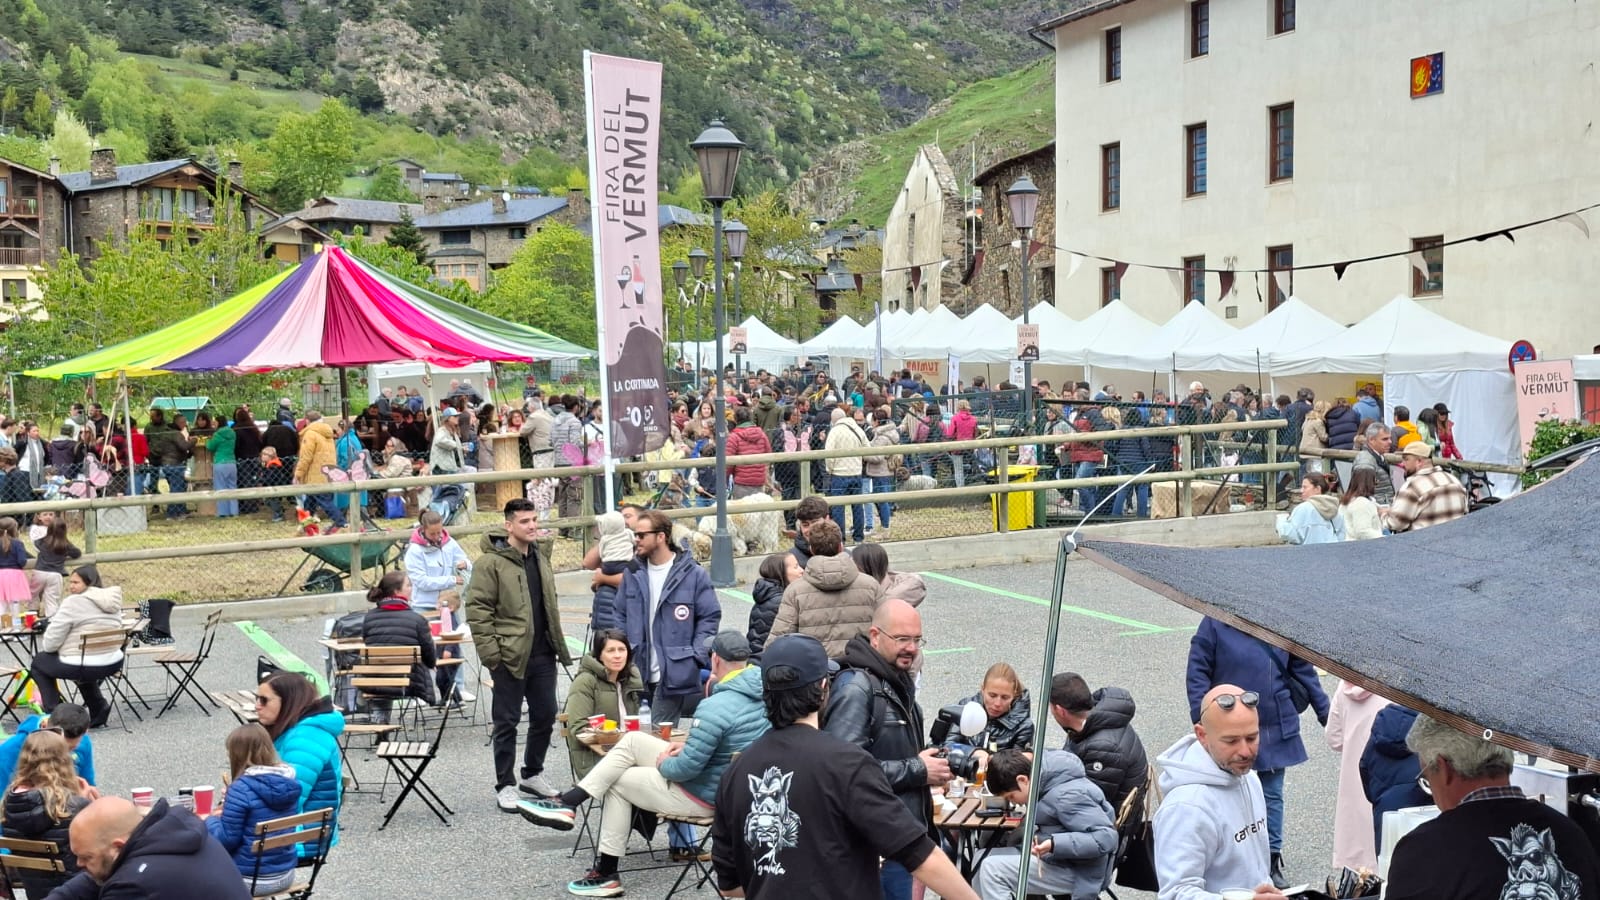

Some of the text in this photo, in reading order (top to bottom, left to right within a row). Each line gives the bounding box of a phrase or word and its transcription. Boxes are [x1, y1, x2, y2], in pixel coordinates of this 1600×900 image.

[603, 104, 621, 222] FIRA DEL
[623, 88, 650, 243] VERMUT
[1526, 372, 1563, 383] FIRA DEL
[613, 381, 623, 393] LA
[1521, 381, 1569, 396] VERMUT
